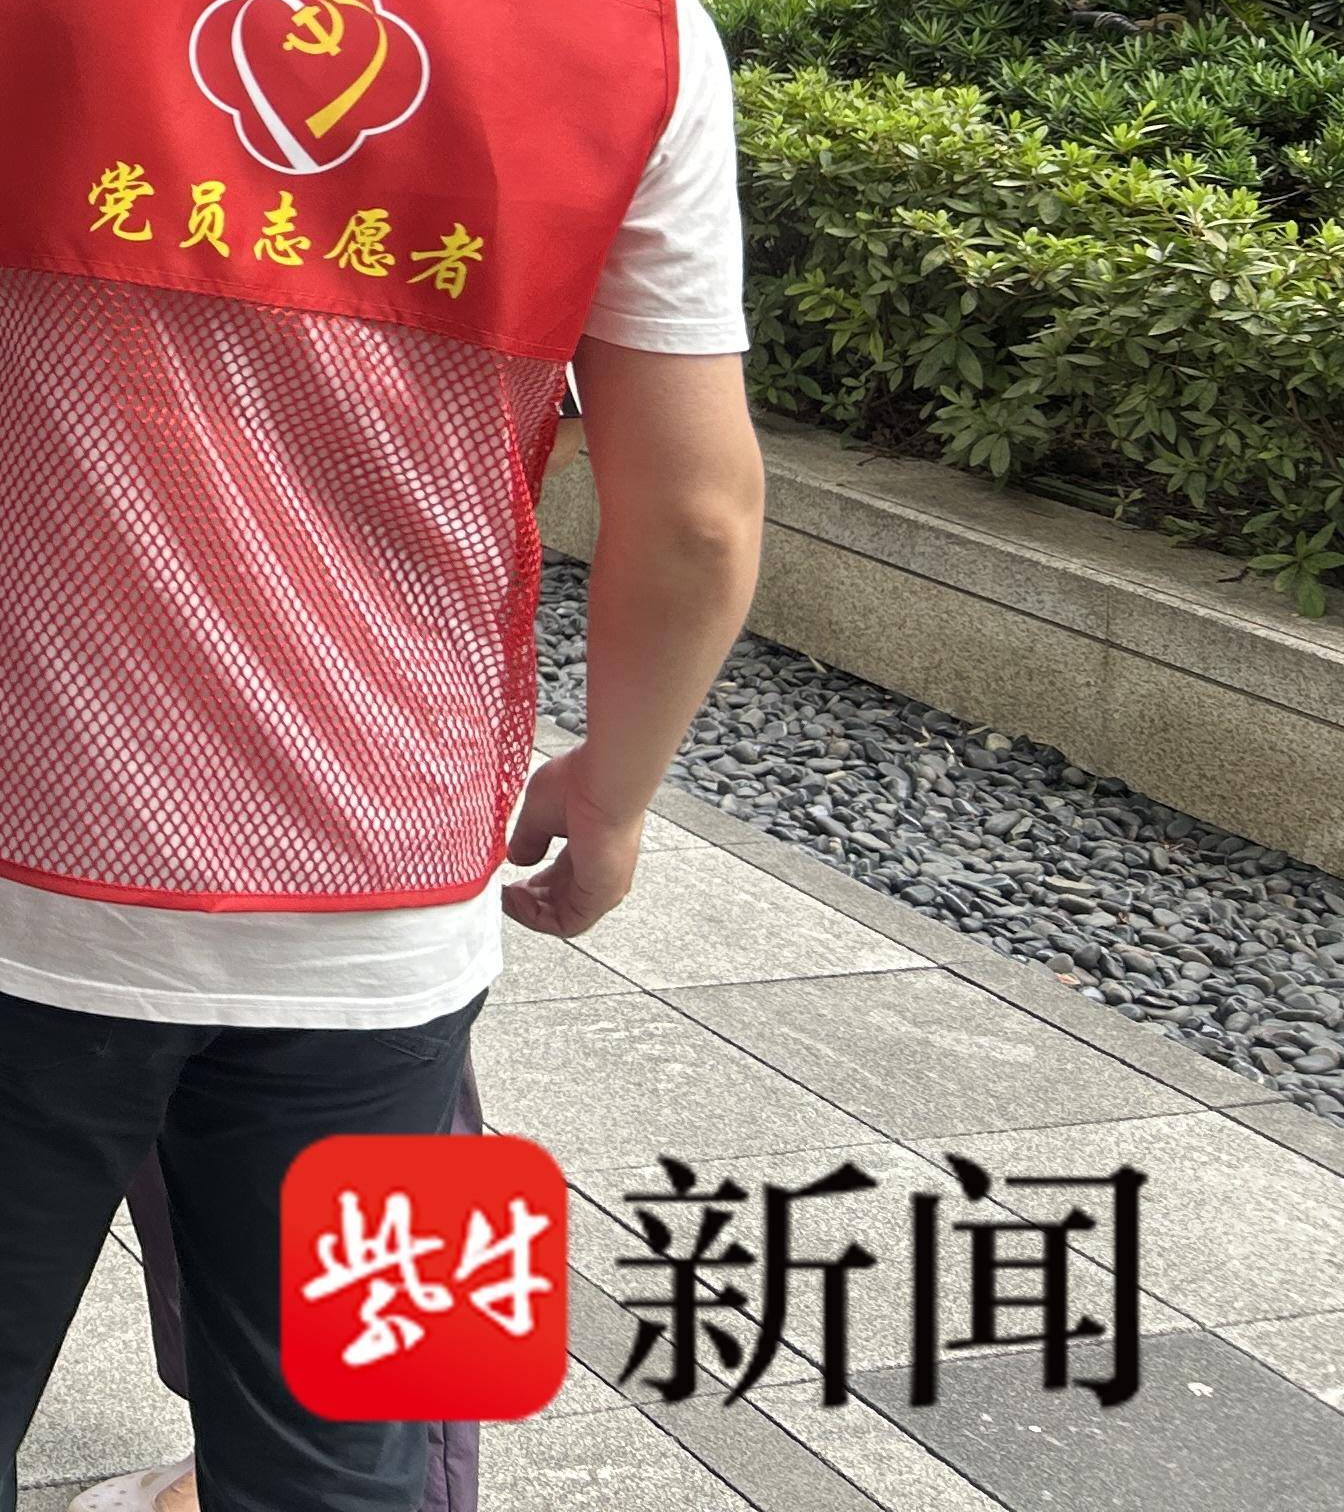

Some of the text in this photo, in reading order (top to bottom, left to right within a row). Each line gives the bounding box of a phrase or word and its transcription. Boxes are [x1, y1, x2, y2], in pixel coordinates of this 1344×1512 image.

[87, 160, 483, 299] 党员志愿者
